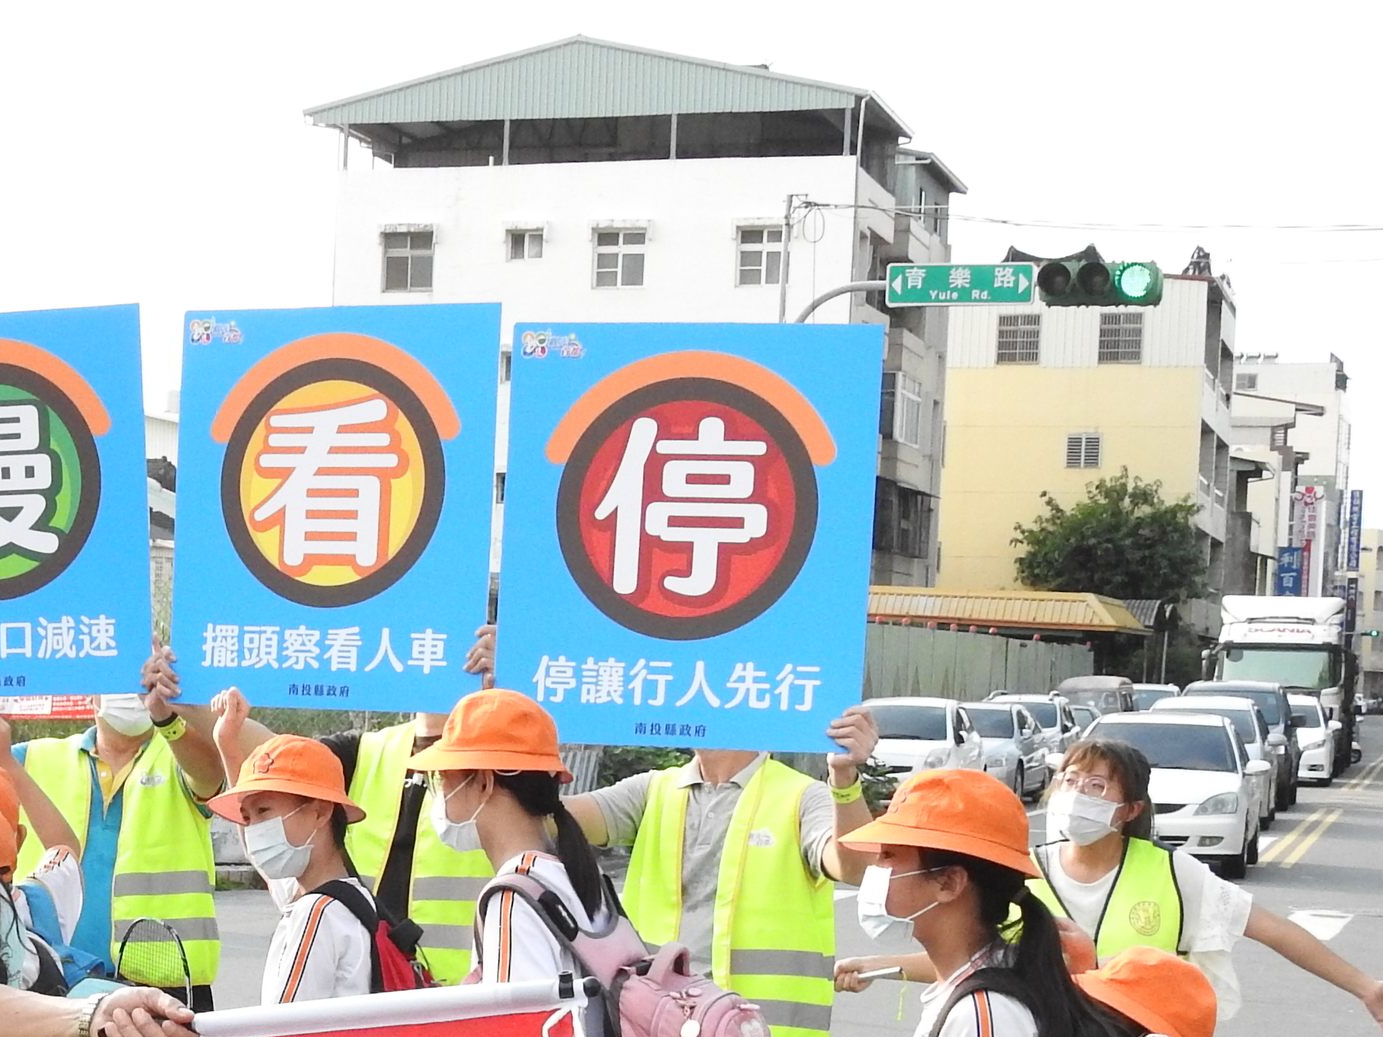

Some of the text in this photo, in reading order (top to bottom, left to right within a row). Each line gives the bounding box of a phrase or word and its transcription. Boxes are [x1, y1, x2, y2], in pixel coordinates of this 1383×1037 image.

[905, 267, 1016, 289] 育樂路
[929, 289, 991, 300] Yule Rd.
[253, 397, 399, 567] 看
[593, 416, 768, 597] 停
[1279, 551, 1298, 597] 利百
[201, 623, 448, 674] 擺頭察看人車
[288, 684, 350, 698] 南投縣政府
[532, 655, 822, 711] 停讓行人先行
[634, 722, 707, 738] 南投縣政府
